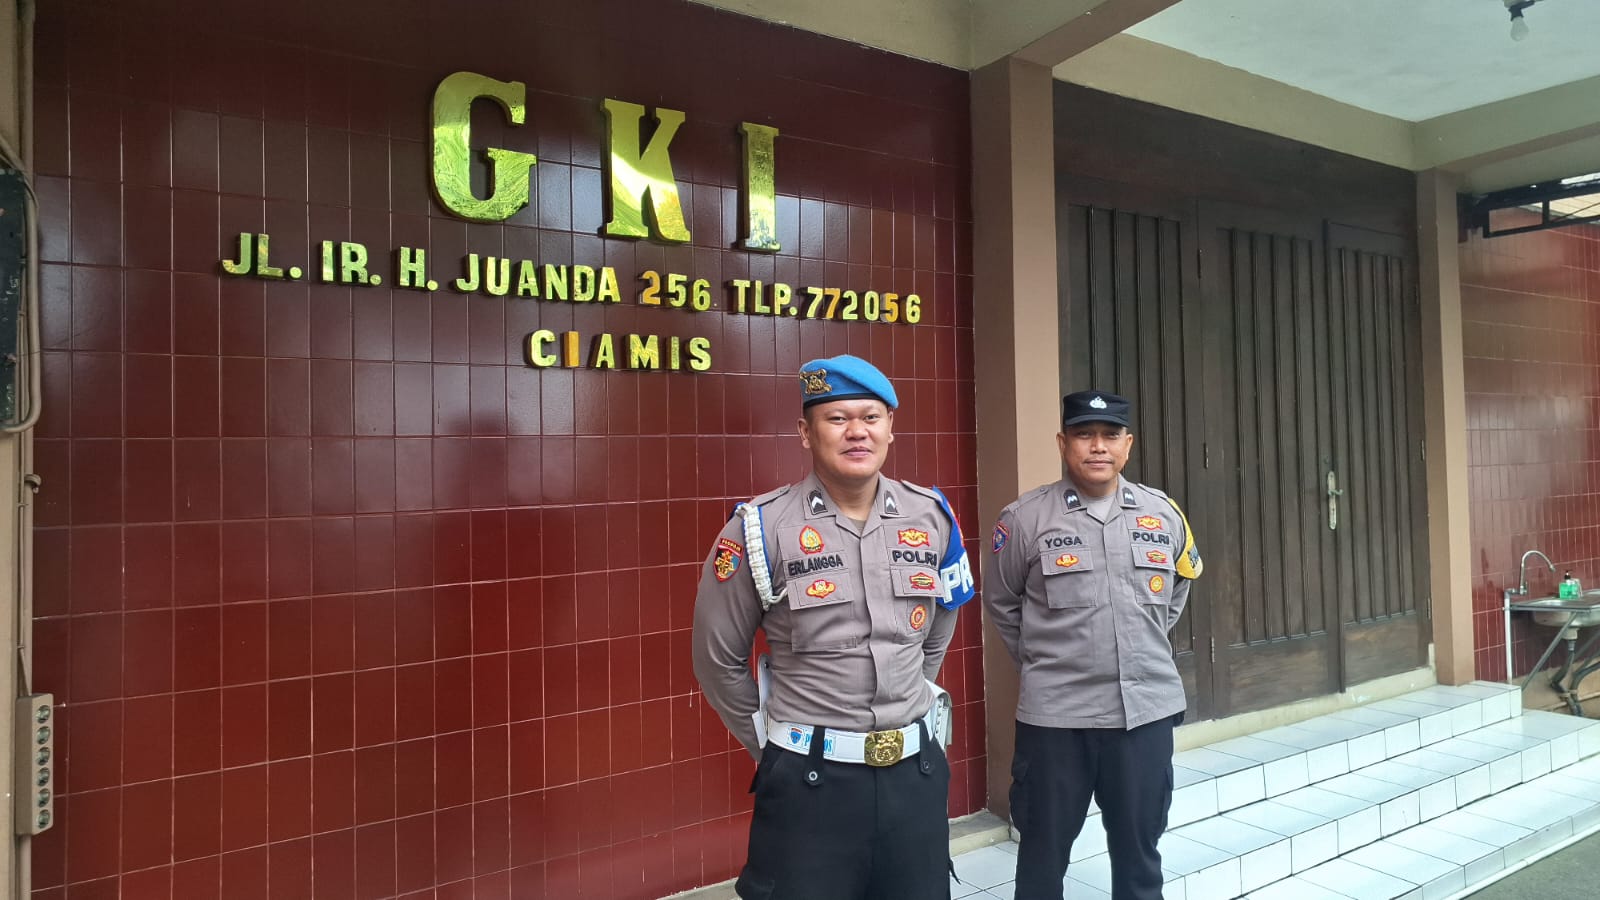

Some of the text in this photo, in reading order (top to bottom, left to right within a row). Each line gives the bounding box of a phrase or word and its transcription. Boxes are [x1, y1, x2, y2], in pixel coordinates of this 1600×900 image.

[432, 71, 781, 251] GKI
[222, 232, 302, 280] JL.
[322, 240, 382, 286] IR.
[399, 246, 438, 291] H.
[455, 253, 621, 303] JUANDA
[639, 270, 710, 311] 256
[529, 329, 711, 371] CIAMIS
[1044, 536, 1083, 549] YOGA
[1132, 532, 1170, 546] POLRI
[788, 553, 844, 575] ERLANGGA
[892, 549, 937, 567] POLRI
